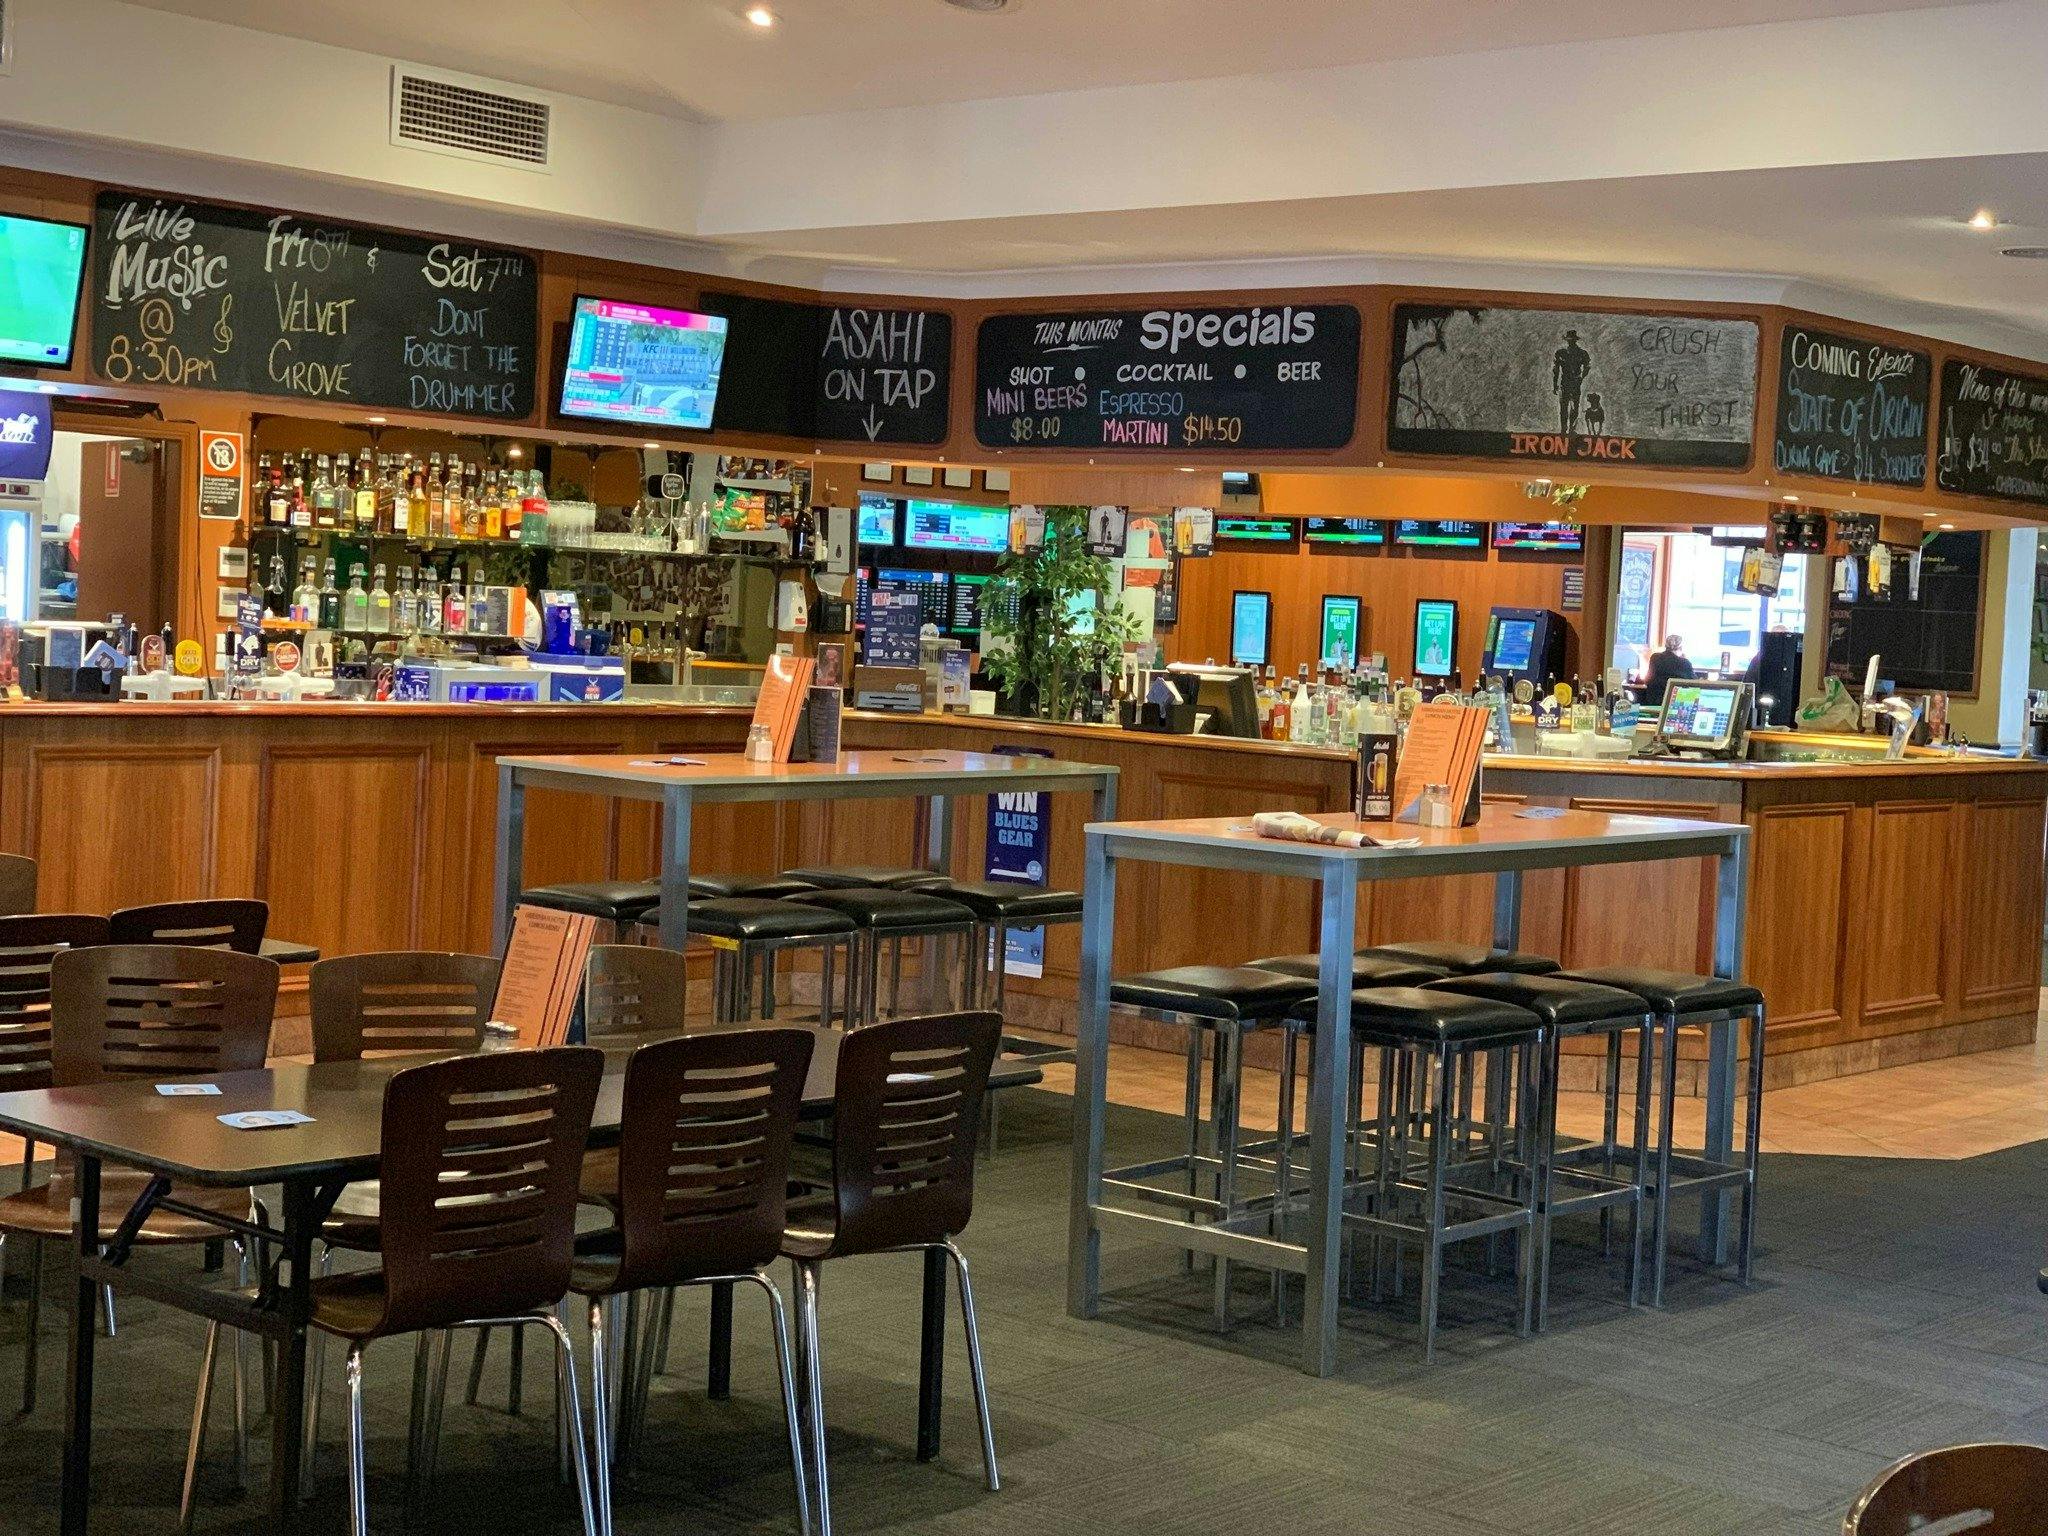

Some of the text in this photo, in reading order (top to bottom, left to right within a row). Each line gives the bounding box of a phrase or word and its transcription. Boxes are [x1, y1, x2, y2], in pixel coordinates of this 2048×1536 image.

[110, 201, 194, 241] Live
[265, 215, 309, 273] Fri
[421, 243, 488, 291] Sat
[105, 244, 228, 311] Music
[141, 299, 174, 341] @
[274, 281, 354, 336] VELVET
[430, 299, 489, 338] DONT
[822, 308, 924, 363] ASAHI
[1034, 307, 1316, 354] THIS MONTHS Specials
[1639, 326, 1722, 355] CRUSH
[268, 338, 351, 396] GROVE
[403, 336, 520, 374] FORGET THE
[1009, 361, 1321, 386] SHOT COCKTAIL BEER
[1792, 333, 1914, 381] COMING Events
[409, 375, 514, 412] DRUMMER
[825, 369, 935, 409] ON TAP
[1631, 366, 1680, 394] YOUR
[1959, 364, 1991, 402] Wine
[987, 384, 1088, 417] MINI BEERS
[1099, 390, 1184, 416] ESPRESSO
[1656, 400, 1739, 429] THIRST
[1788, 367, 1924, 442] STATE OF ORIGIN
[1103, 419, 1168, 446] MARTINI
[1510, 433, 1637, 460] IRON JACK
[240, 658, 259, 667] DRY
[1537, 715, 1558, 725] DRY
[997, 791, 1038, 813] WIN
[995, 812, 1039, 831] BLUES
[998, 829, 1034, 848] GEAR
